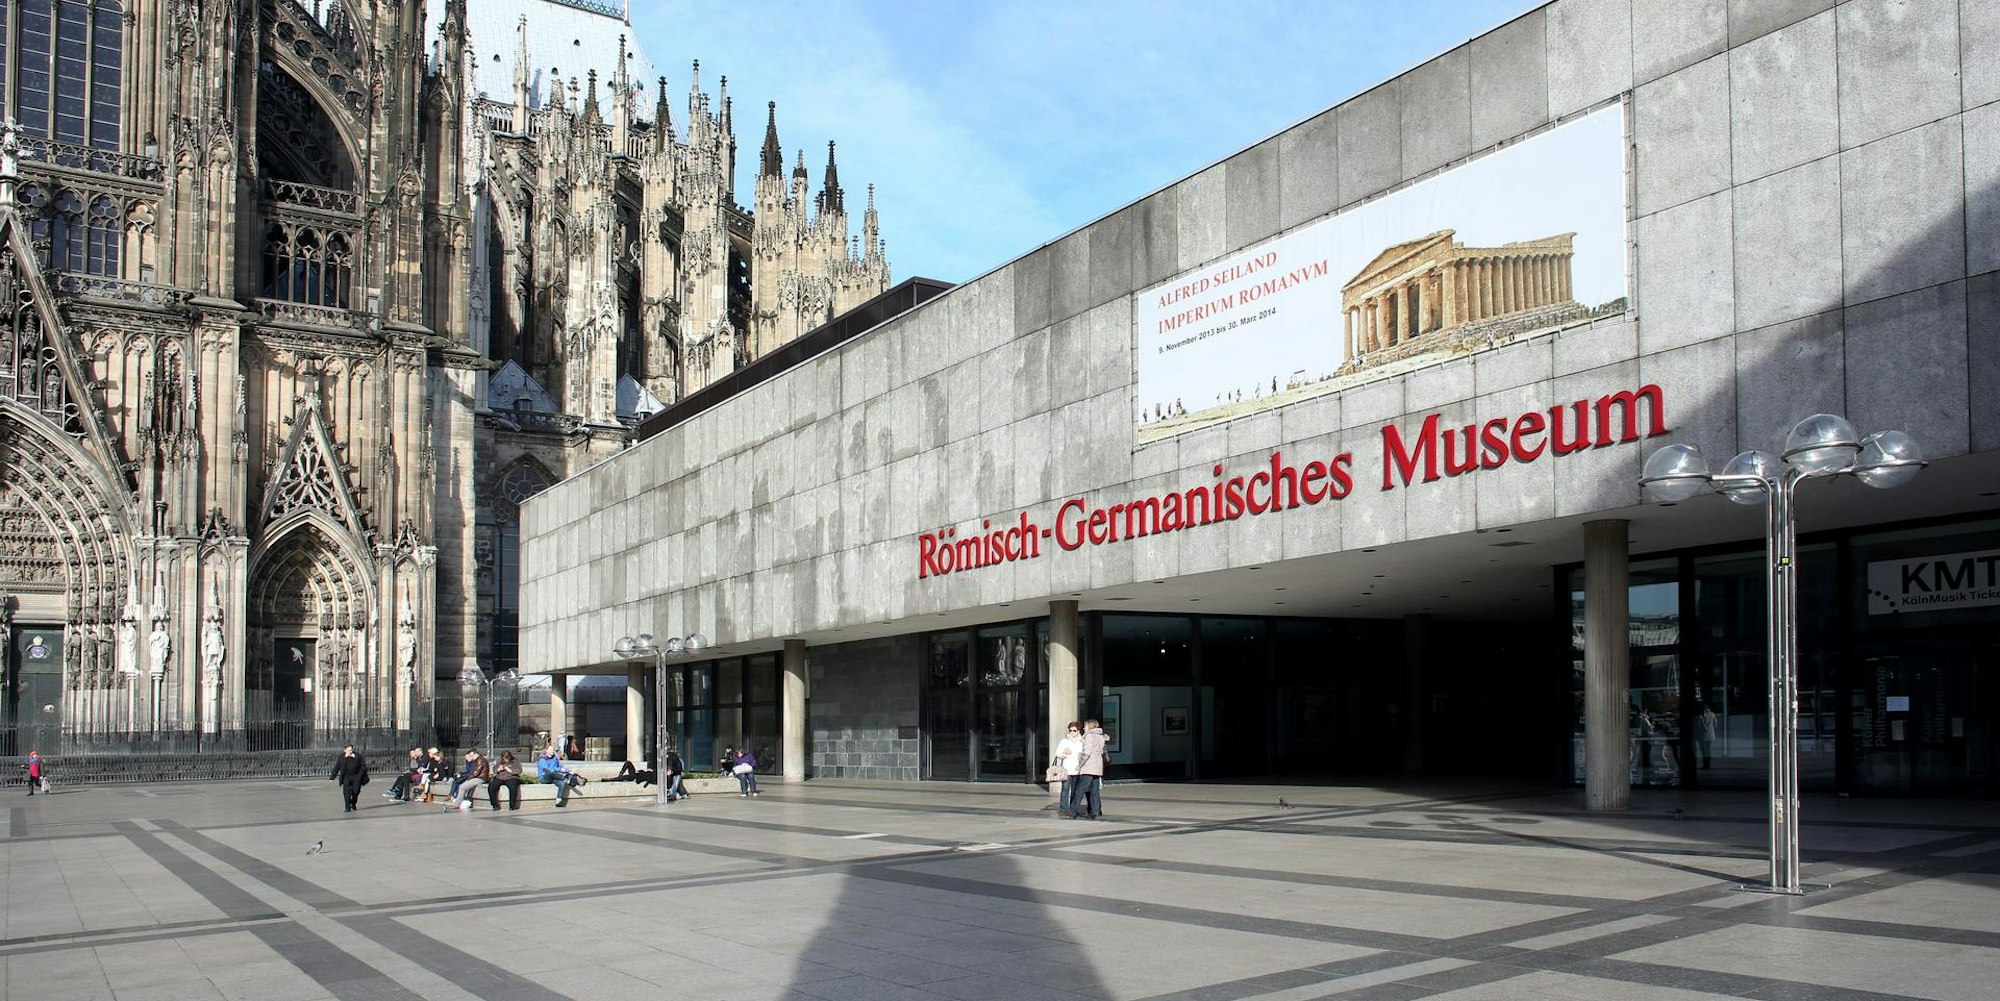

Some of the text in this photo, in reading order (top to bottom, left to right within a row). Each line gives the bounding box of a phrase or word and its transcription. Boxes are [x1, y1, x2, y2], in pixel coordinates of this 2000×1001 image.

[1158, 252, 1277, 309] ALFRED SEILAND
[1158, 259, 1329, 334] IMPERIVM ROMANVM
[1158, 307, 1276, 354] 9. November 2013 bis 30. März 2014
[918, 383, 1670, 579] Römisch-Germanisches Museum
[1902, 555, 2000, 594] KMT
[1902, 592, 1967, 606] KölnMusik
[1875, 665, 1887, 747] Philharmonie
